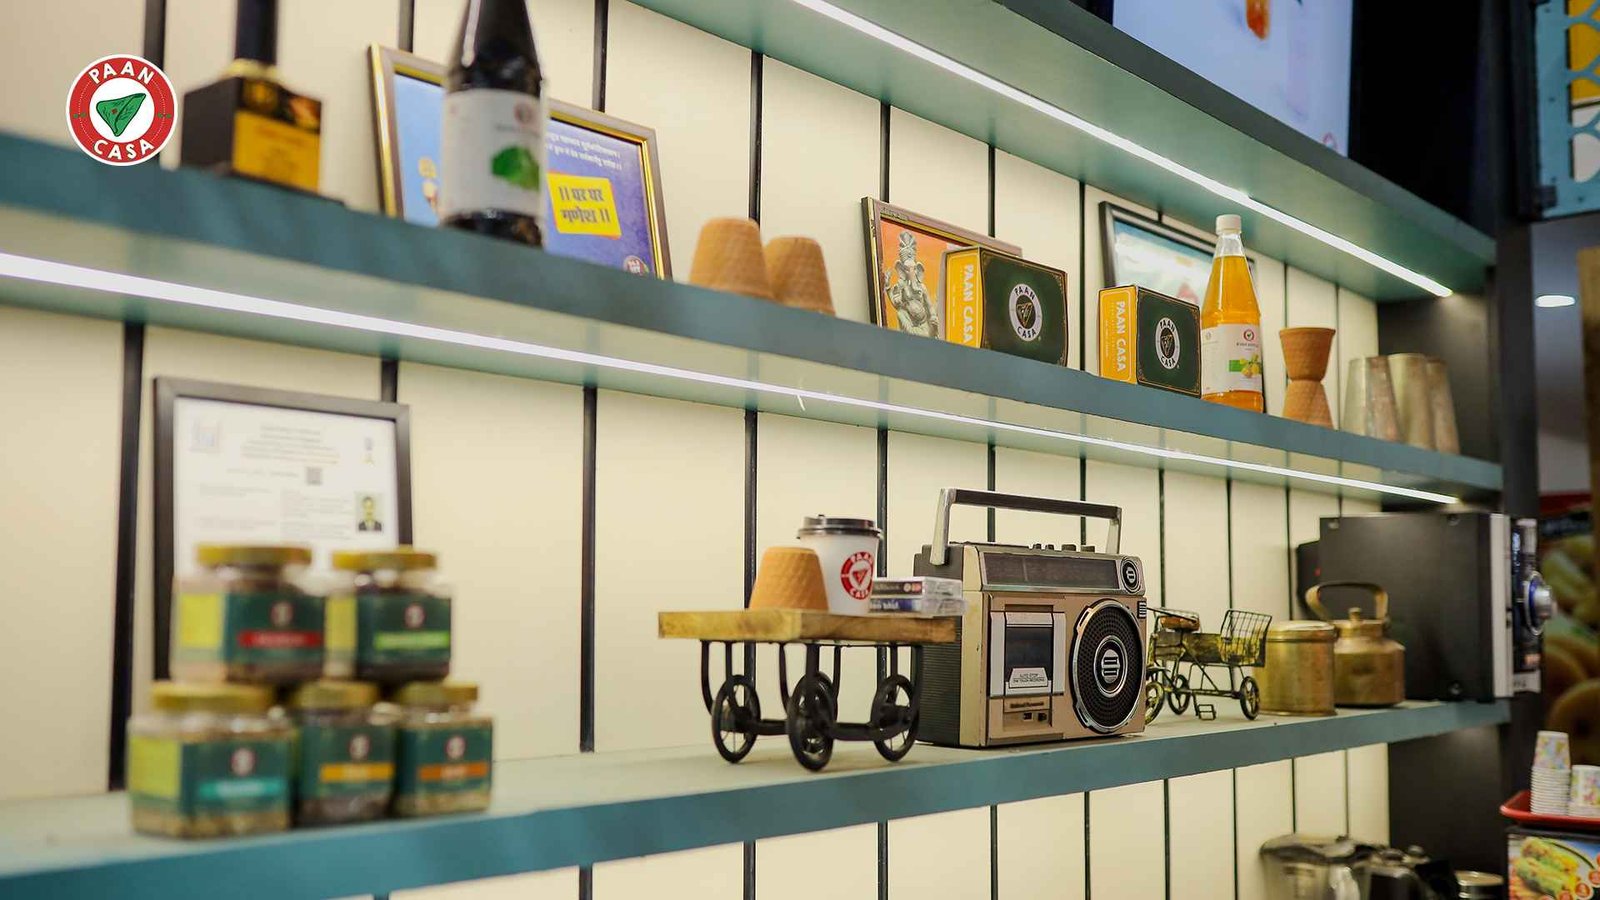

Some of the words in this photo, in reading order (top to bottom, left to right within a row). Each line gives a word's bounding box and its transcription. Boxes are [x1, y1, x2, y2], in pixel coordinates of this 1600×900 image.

[964, 263, 974, 302] PAAN
[1014, 286, 1036, 300] PAAN
[963, 306, 974, 343] CASA
[1116, 301, 1126, 334] PAAN
[1160, 319, 1176, 333] PAAN
[1017, 326, 1037, 338] CASA
[1116, 338, 1127, 372] CASA
[1161, 355, 1176, 367] CASA
